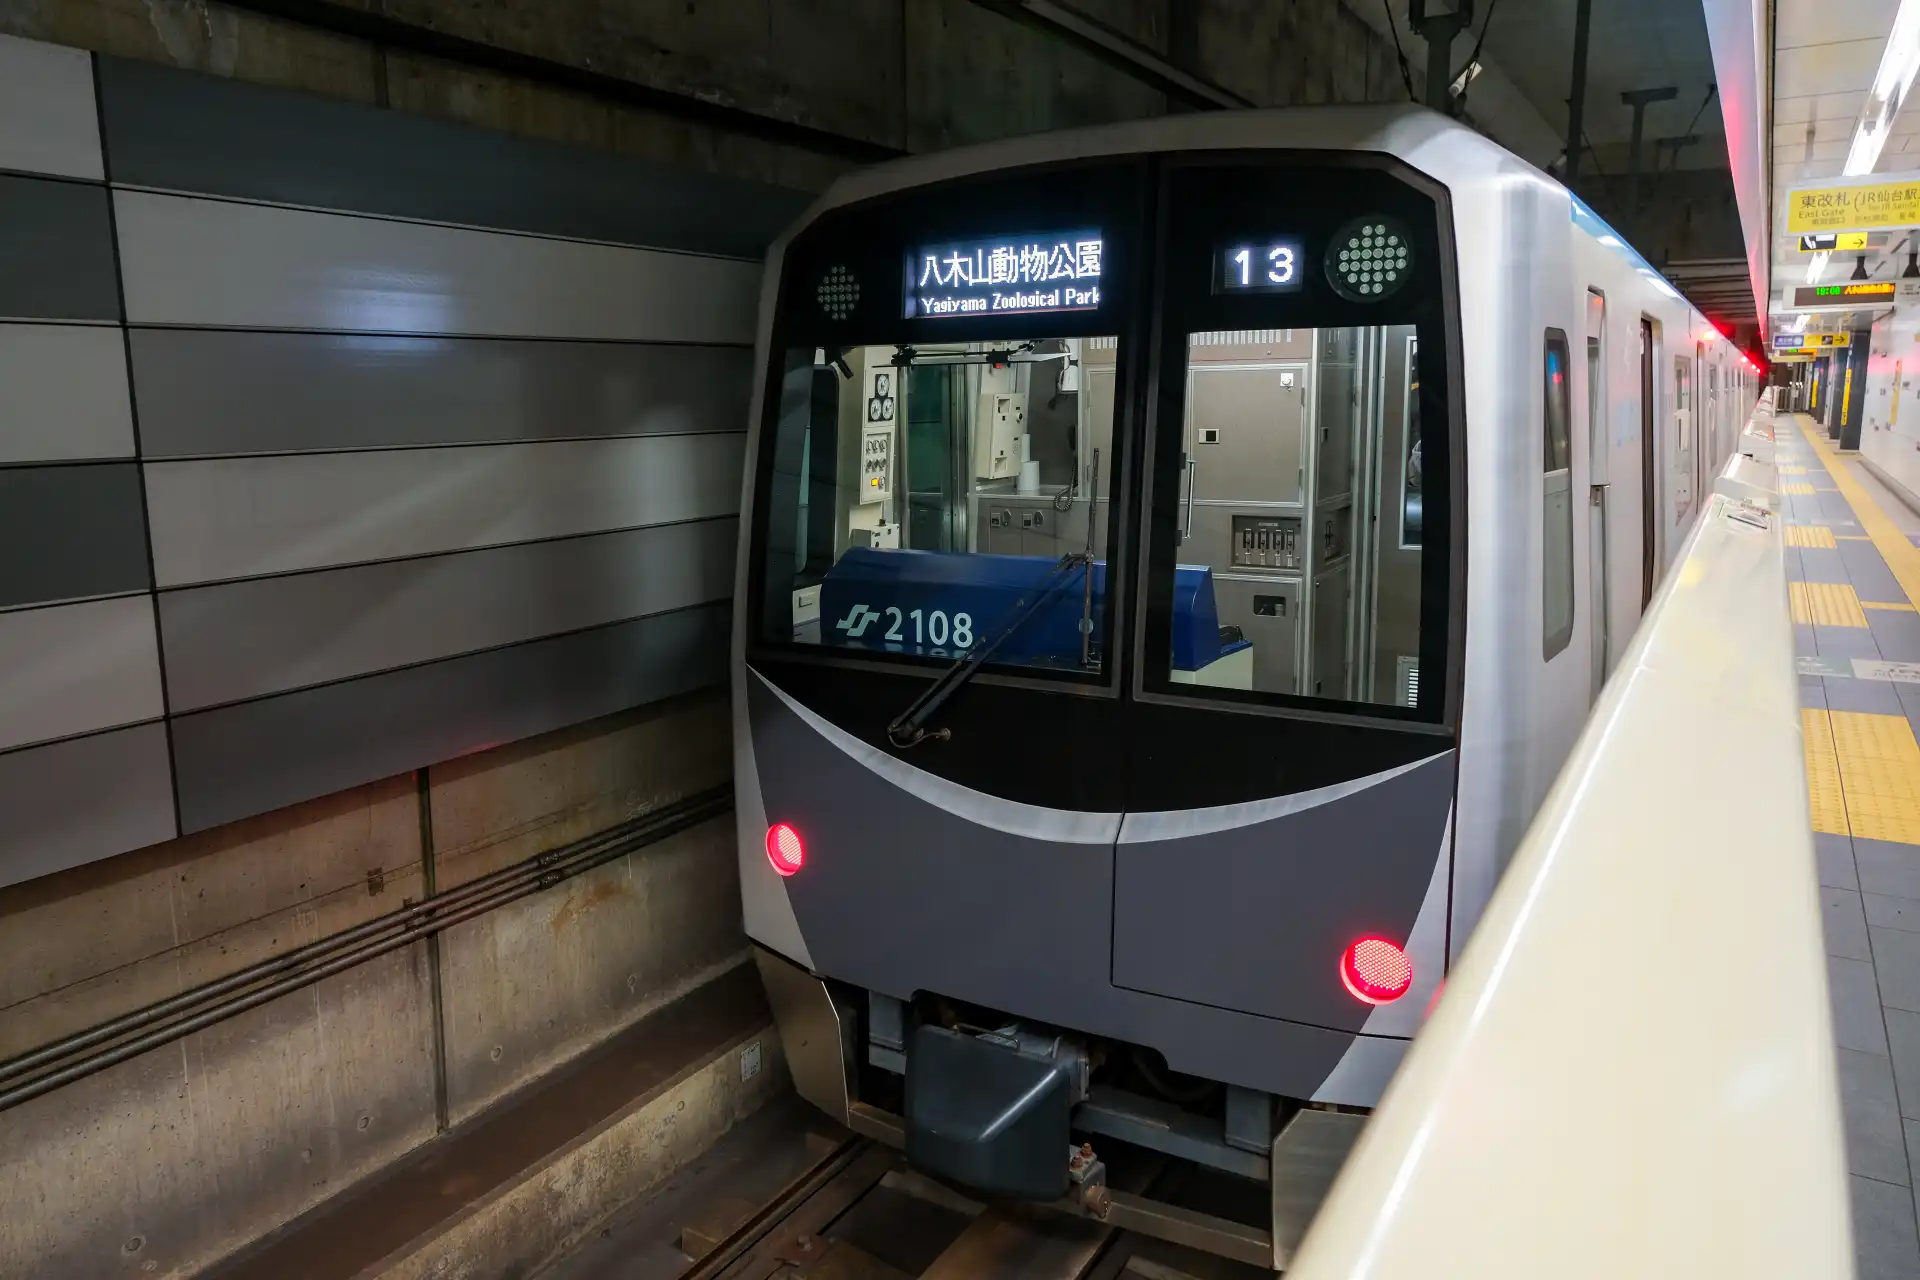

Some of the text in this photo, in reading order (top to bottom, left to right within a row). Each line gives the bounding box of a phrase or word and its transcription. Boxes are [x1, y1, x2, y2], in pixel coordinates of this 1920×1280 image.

[1800, 188, 1920, 212] 東改札 (JR仙台駅
[920, 240, 1102, 287] 八木山動物公園
[1234, 246, 1294, 285] 13
[921, 286, 1100, 314] Yagiyama Zoological Park
[884, 606, 973, 648] 2108
